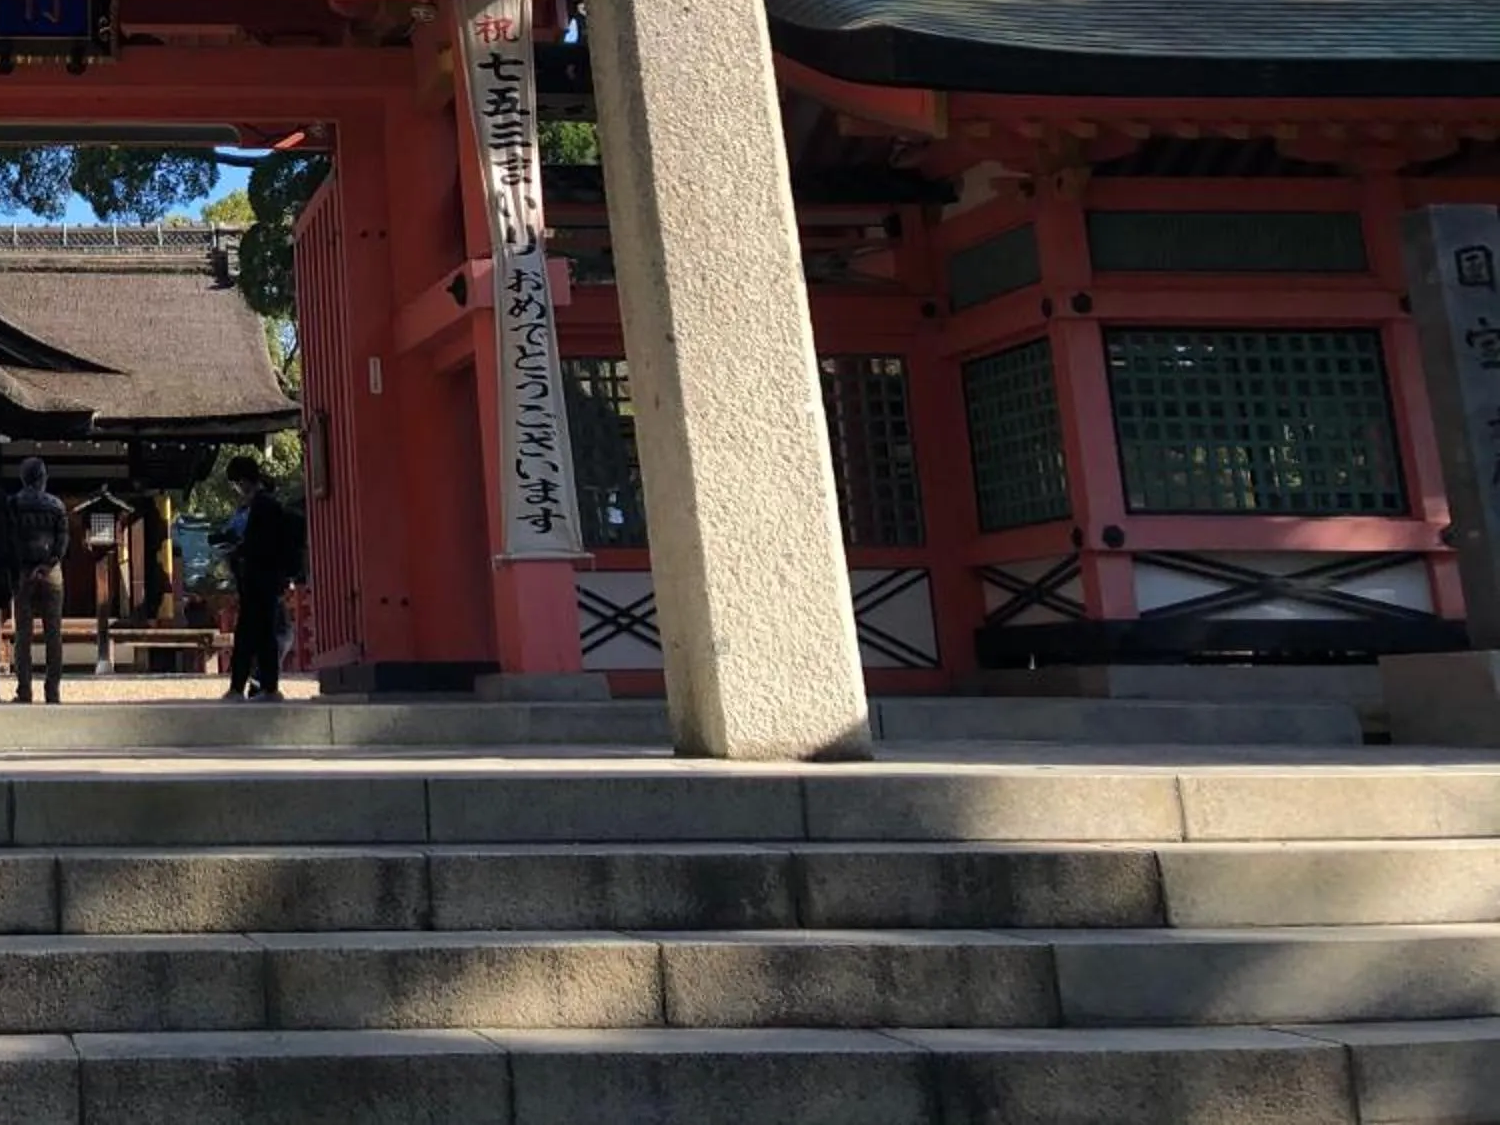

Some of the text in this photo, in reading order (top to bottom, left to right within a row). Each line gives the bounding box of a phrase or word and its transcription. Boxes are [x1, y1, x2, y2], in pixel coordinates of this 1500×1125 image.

[506, 269, 566, 534] おめでとうございます
